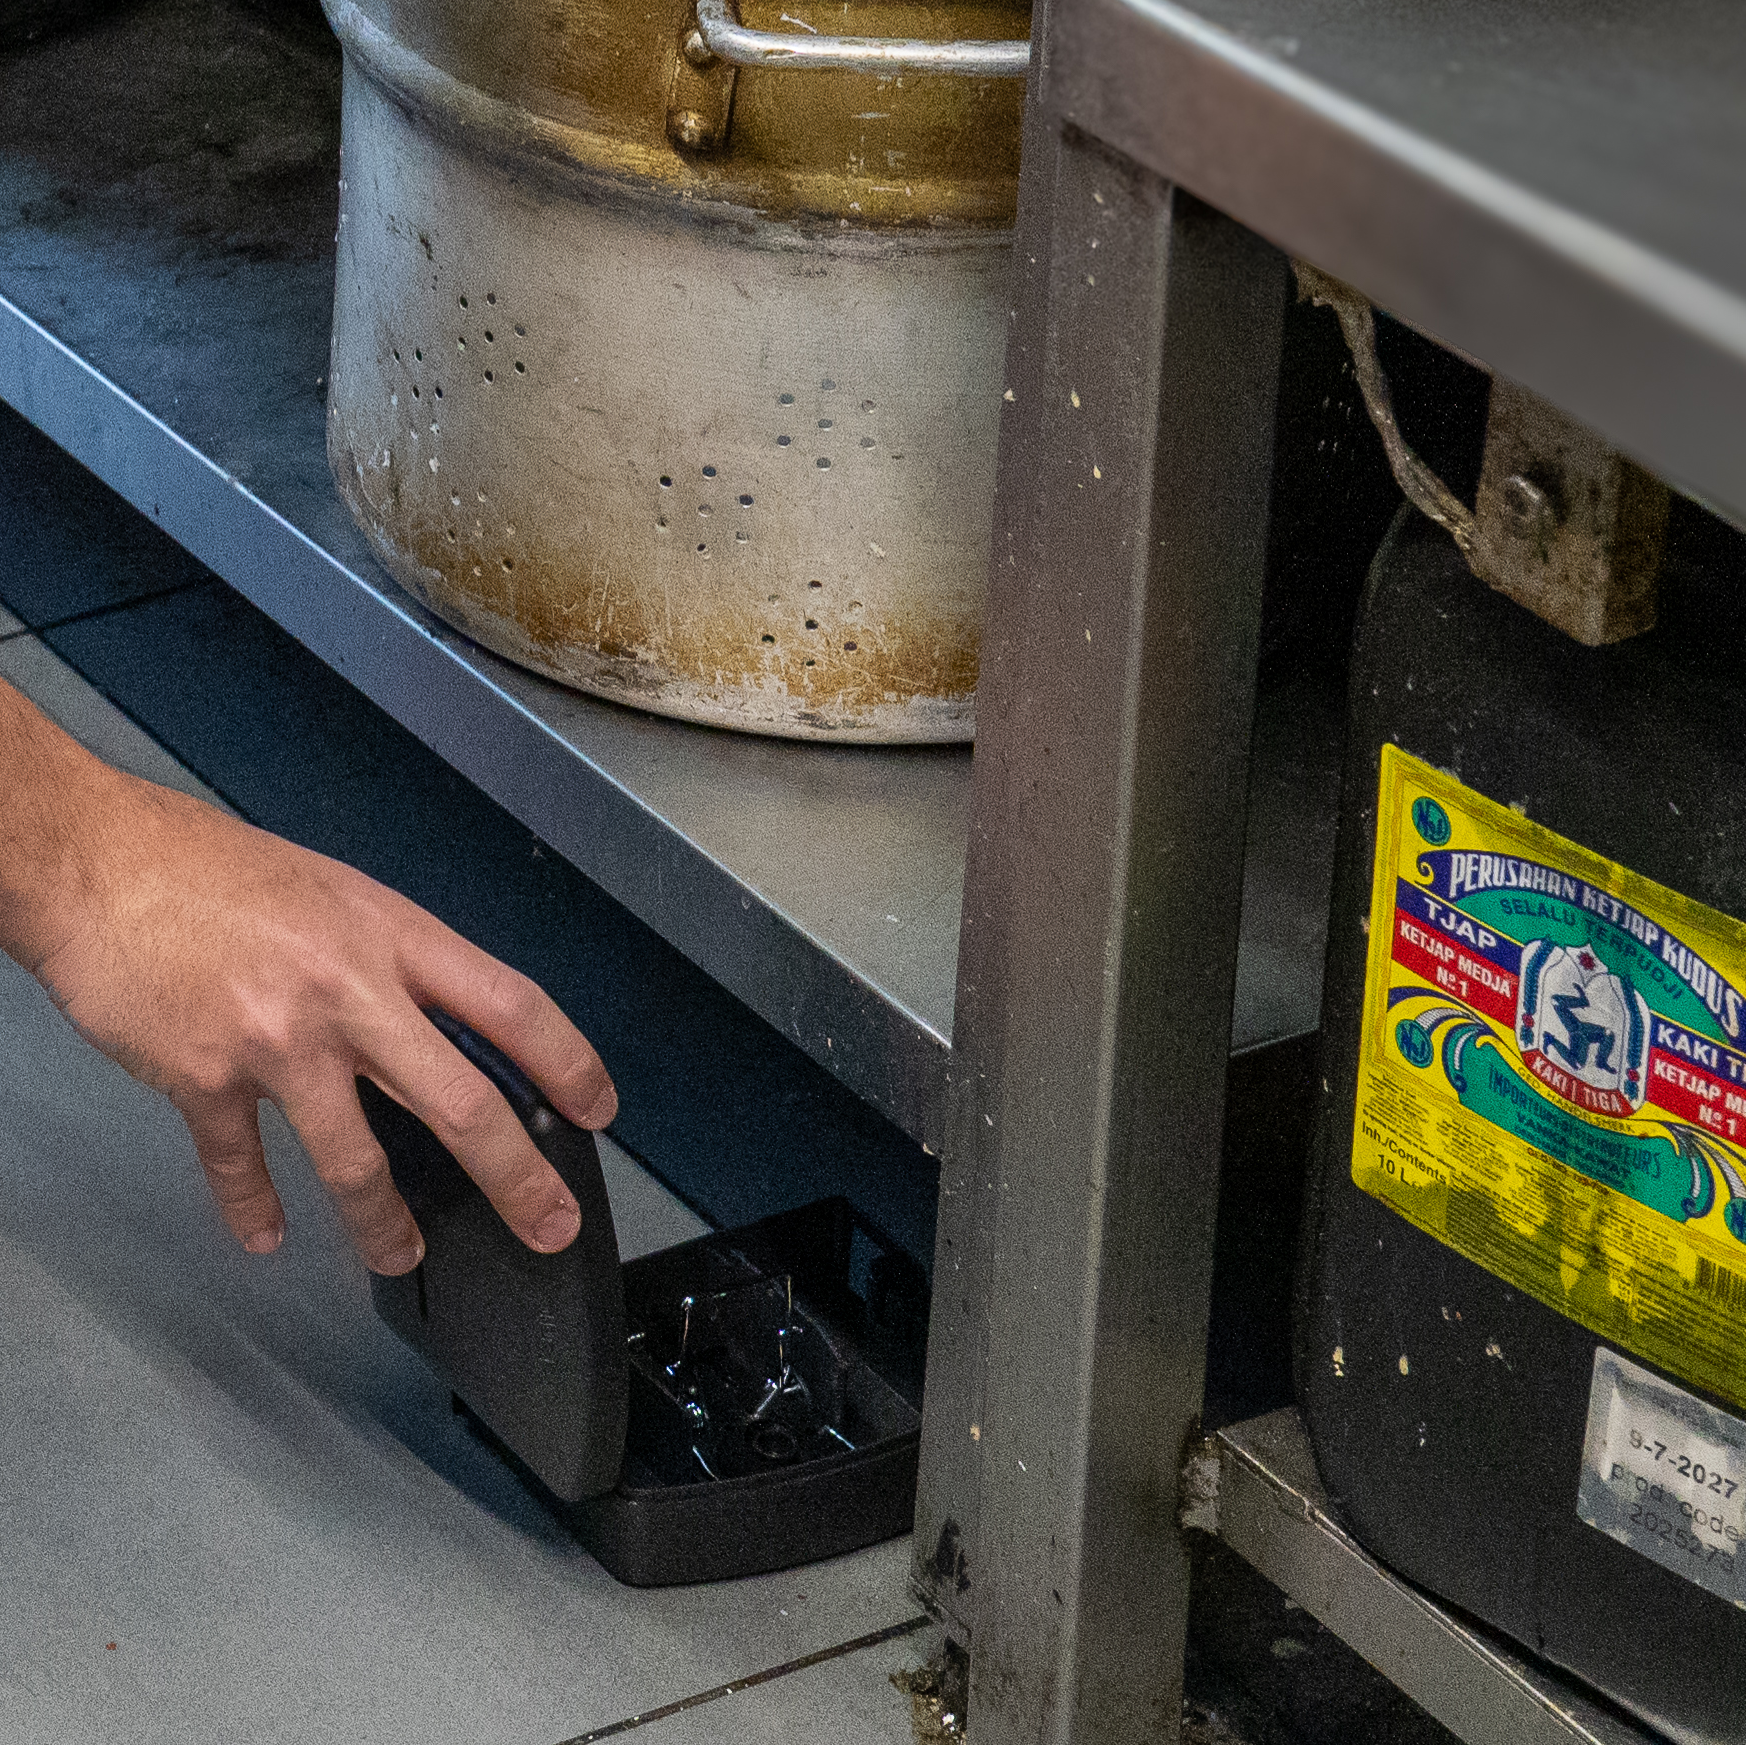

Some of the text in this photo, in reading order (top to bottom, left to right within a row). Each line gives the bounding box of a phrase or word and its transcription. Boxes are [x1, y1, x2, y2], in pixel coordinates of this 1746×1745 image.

[1423, 897, 1497, 949] TJAP
[1449, 853, 1742, 1037] PERUSAHAN KETJAP KUDUS
[1400, 920, 1510, 998] KETJAP MEDJA
[1500, 897, 1683, 1000] SELALU TERPUDJI
[1657, 1023, 1718, 1068] KAKI
[1532, 1056, 1623, 1113] KAKI TIGA
[1654, 1058, 1721, 1100] KETJAP
[1726, 1118, 1737, 1136] 1
[1378, 1154, 1395, 1174] 10
[1679, 1501, 1740, 1541] code
